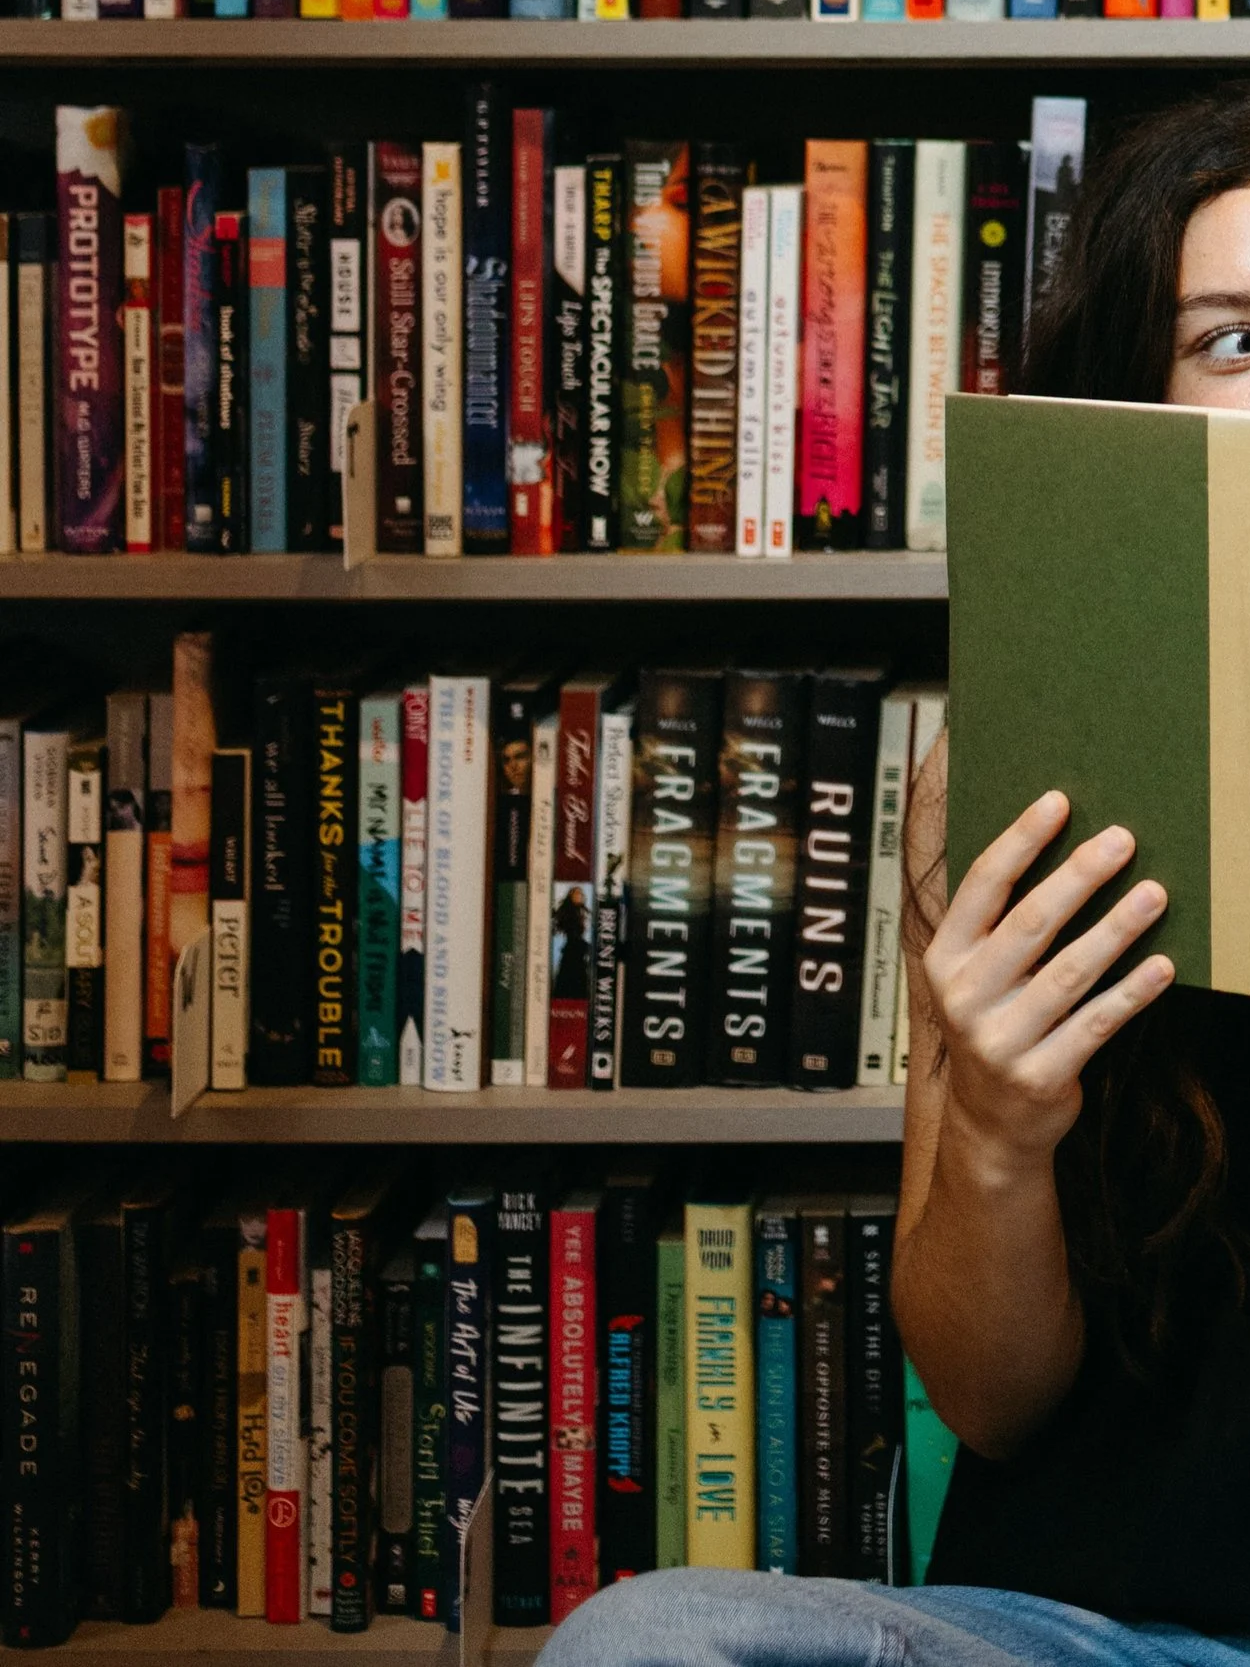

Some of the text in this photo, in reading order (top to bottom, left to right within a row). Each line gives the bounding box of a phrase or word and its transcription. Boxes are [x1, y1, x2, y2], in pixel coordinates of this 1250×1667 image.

[68, 185, 100, 392] PROTOTYPE
[430, 189, 458, 412] hope is our only wing
[592, 168, 611, 240] THARP
[390, 256, 416, 466] Still Star-Crossed
[590, 276, 611, 431] SPECTACULAR
[590, 437, 610, 496] NOW
[319, 700, 344, 846] THANKS
[319, 852, 338, 874] for
[318, 900, 344, 1068] TROUBLE
[642, 746, 696, 1041] FRAGMENTS
[724, 742, 781, 1038] FRAGMENTS
[799, 780, 855, 994] RUINS
[497, 1255, 543, 1545] THE INFINITE SEA
[561, 1275, 583, 1532] ABSOLUTELY MAYBE
[696, 1453, 736, 1522] LOVE
